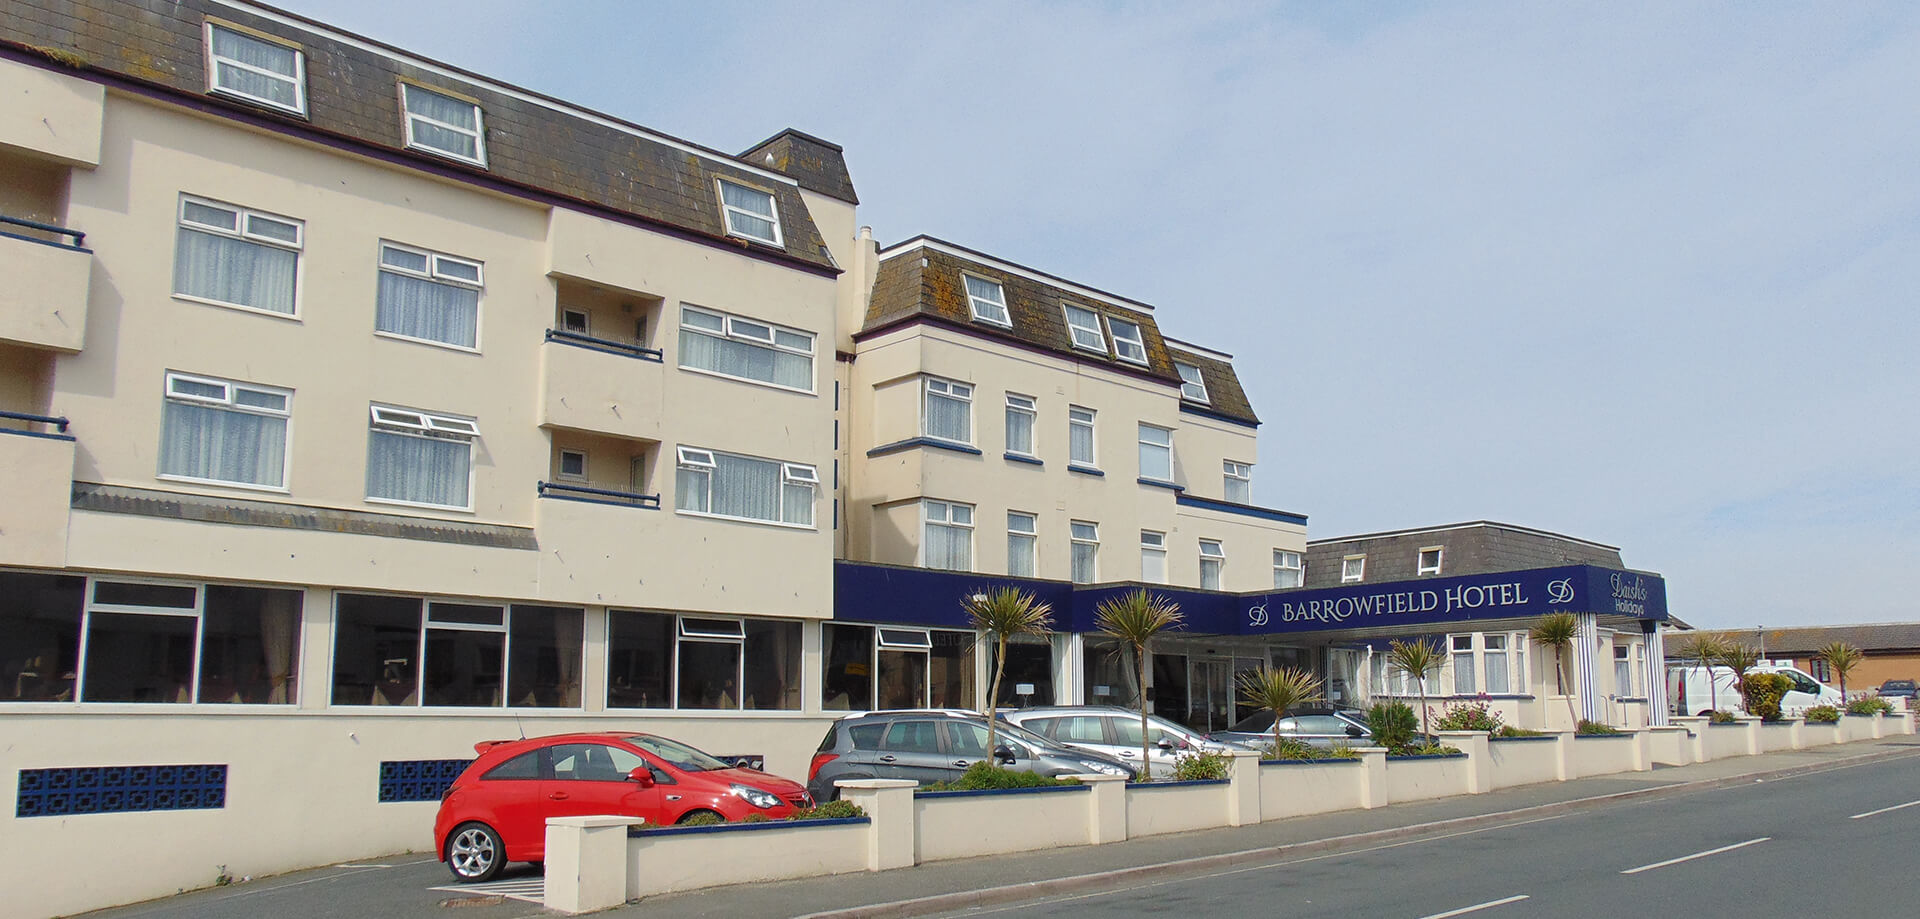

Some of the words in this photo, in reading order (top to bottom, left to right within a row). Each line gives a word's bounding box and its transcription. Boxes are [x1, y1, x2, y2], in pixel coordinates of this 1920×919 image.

[1610, 572, 1648, 599] Daish's
[1281, 591, 1438, 623] BARROWFIELD
[1444, 583, 1529, 613] HOTEL
[1615, 598, 1645, 616] Holidays
